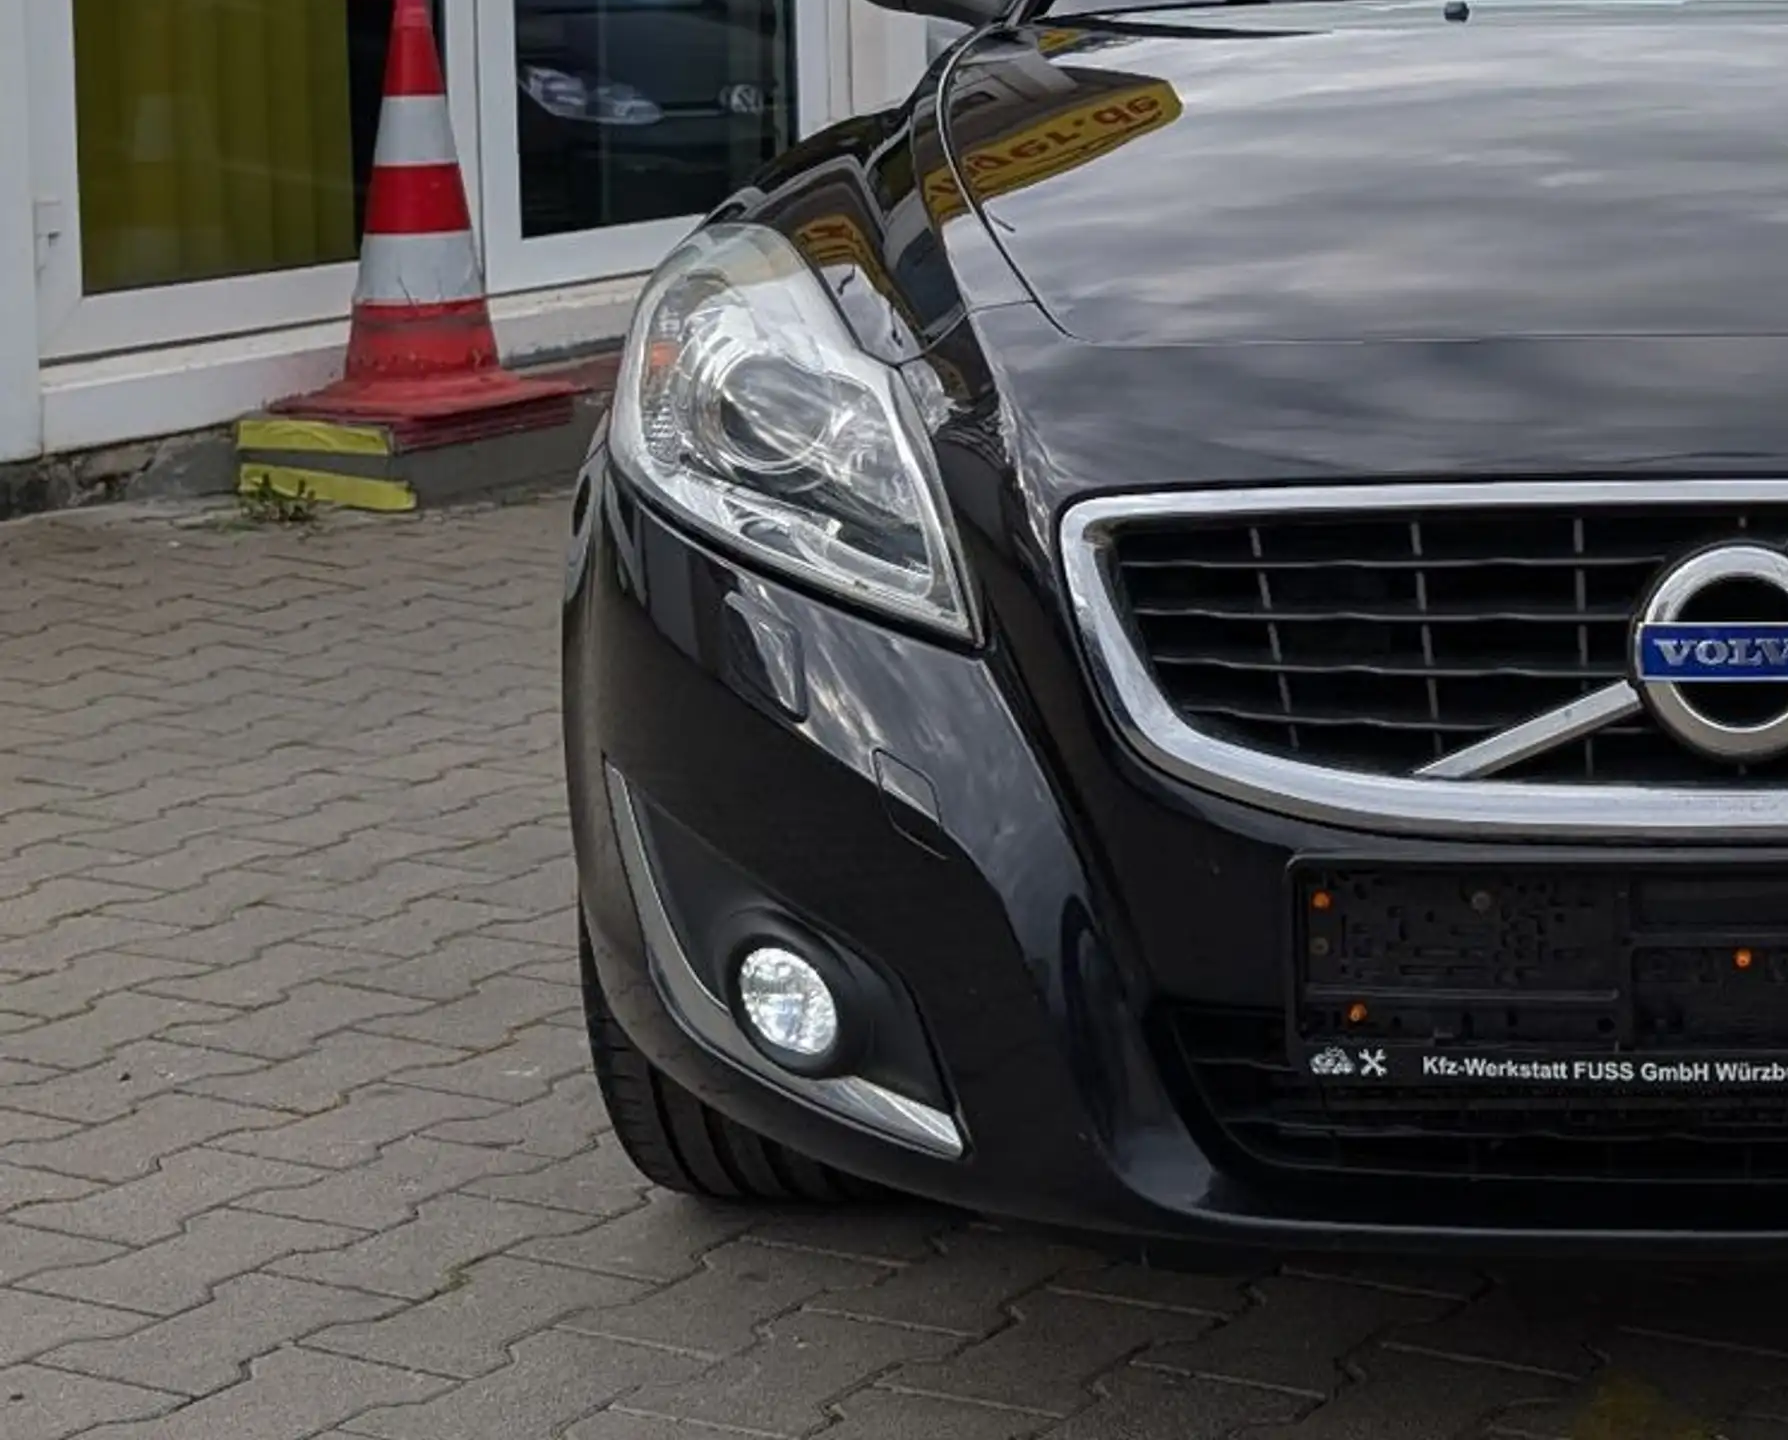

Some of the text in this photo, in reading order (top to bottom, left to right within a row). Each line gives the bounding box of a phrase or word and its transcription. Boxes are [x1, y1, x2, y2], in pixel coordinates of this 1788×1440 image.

[1422, 1055, 1568, 1081] Kfz-Werkstatt
[1573, 1061, 1634, 1080] FUSS
[1640, 1061, 1709, 1082] GmbH
